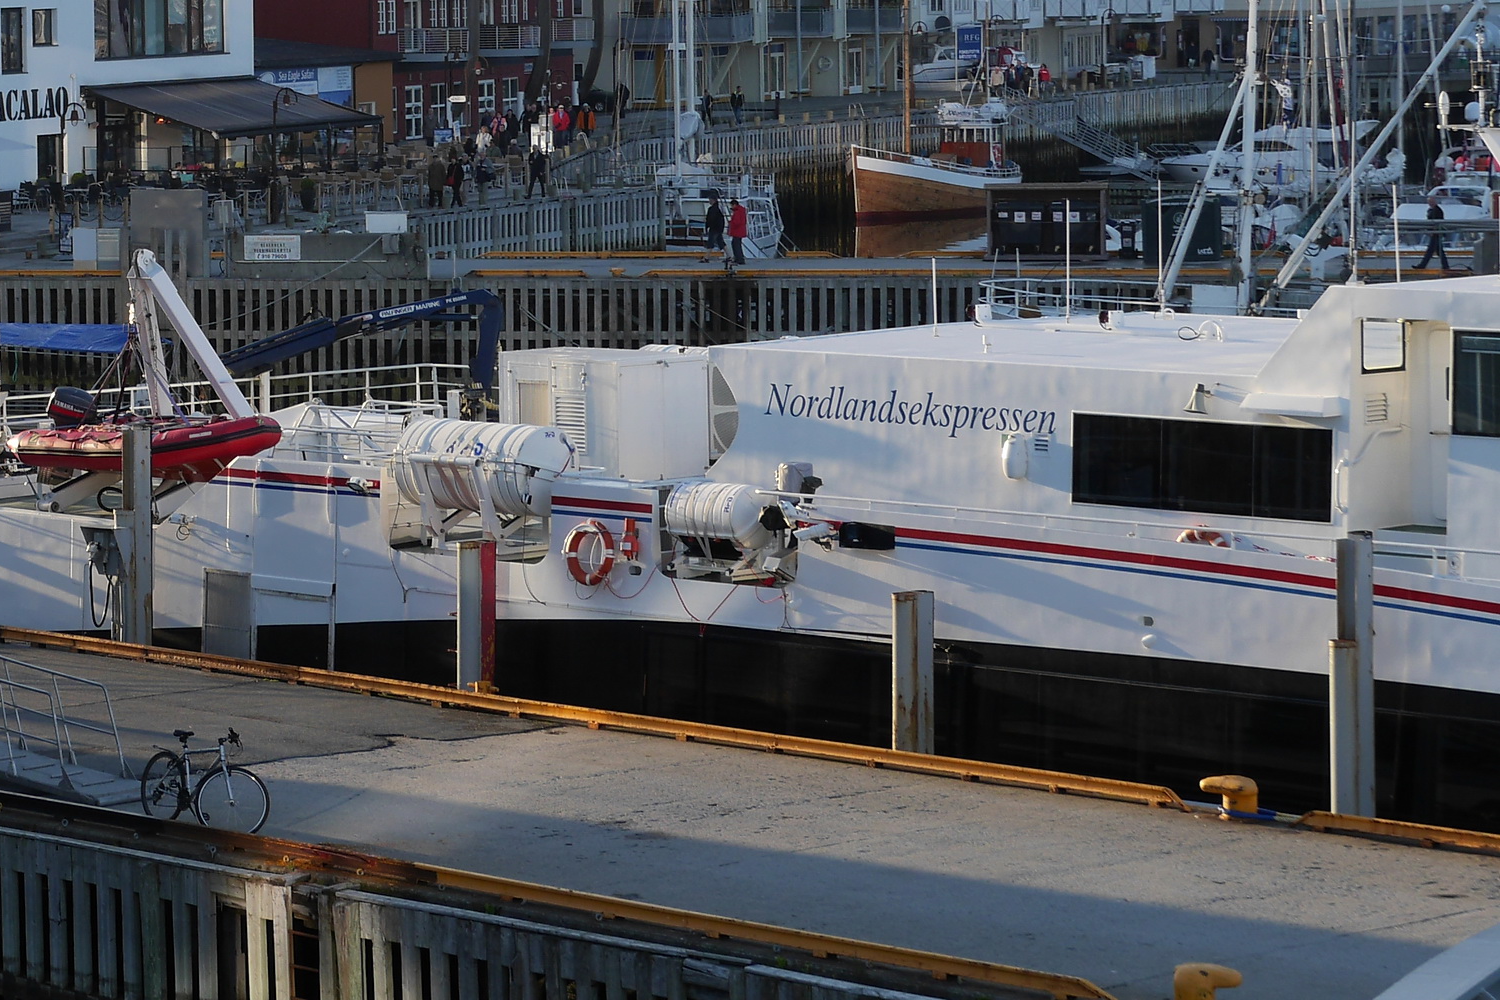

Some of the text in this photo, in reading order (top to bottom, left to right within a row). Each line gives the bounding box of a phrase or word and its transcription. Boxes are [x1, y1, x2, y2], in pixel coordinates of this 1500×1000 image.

[964, 33, 980, 41] RFG
[278, 68, 315, 83] Sea Eagle Safari
[415, 301, 441, 311] MARINE
[54, 399, 74, 411] YAMAHA
[764, 383, 1057, 438] Nordlandsekspressen
